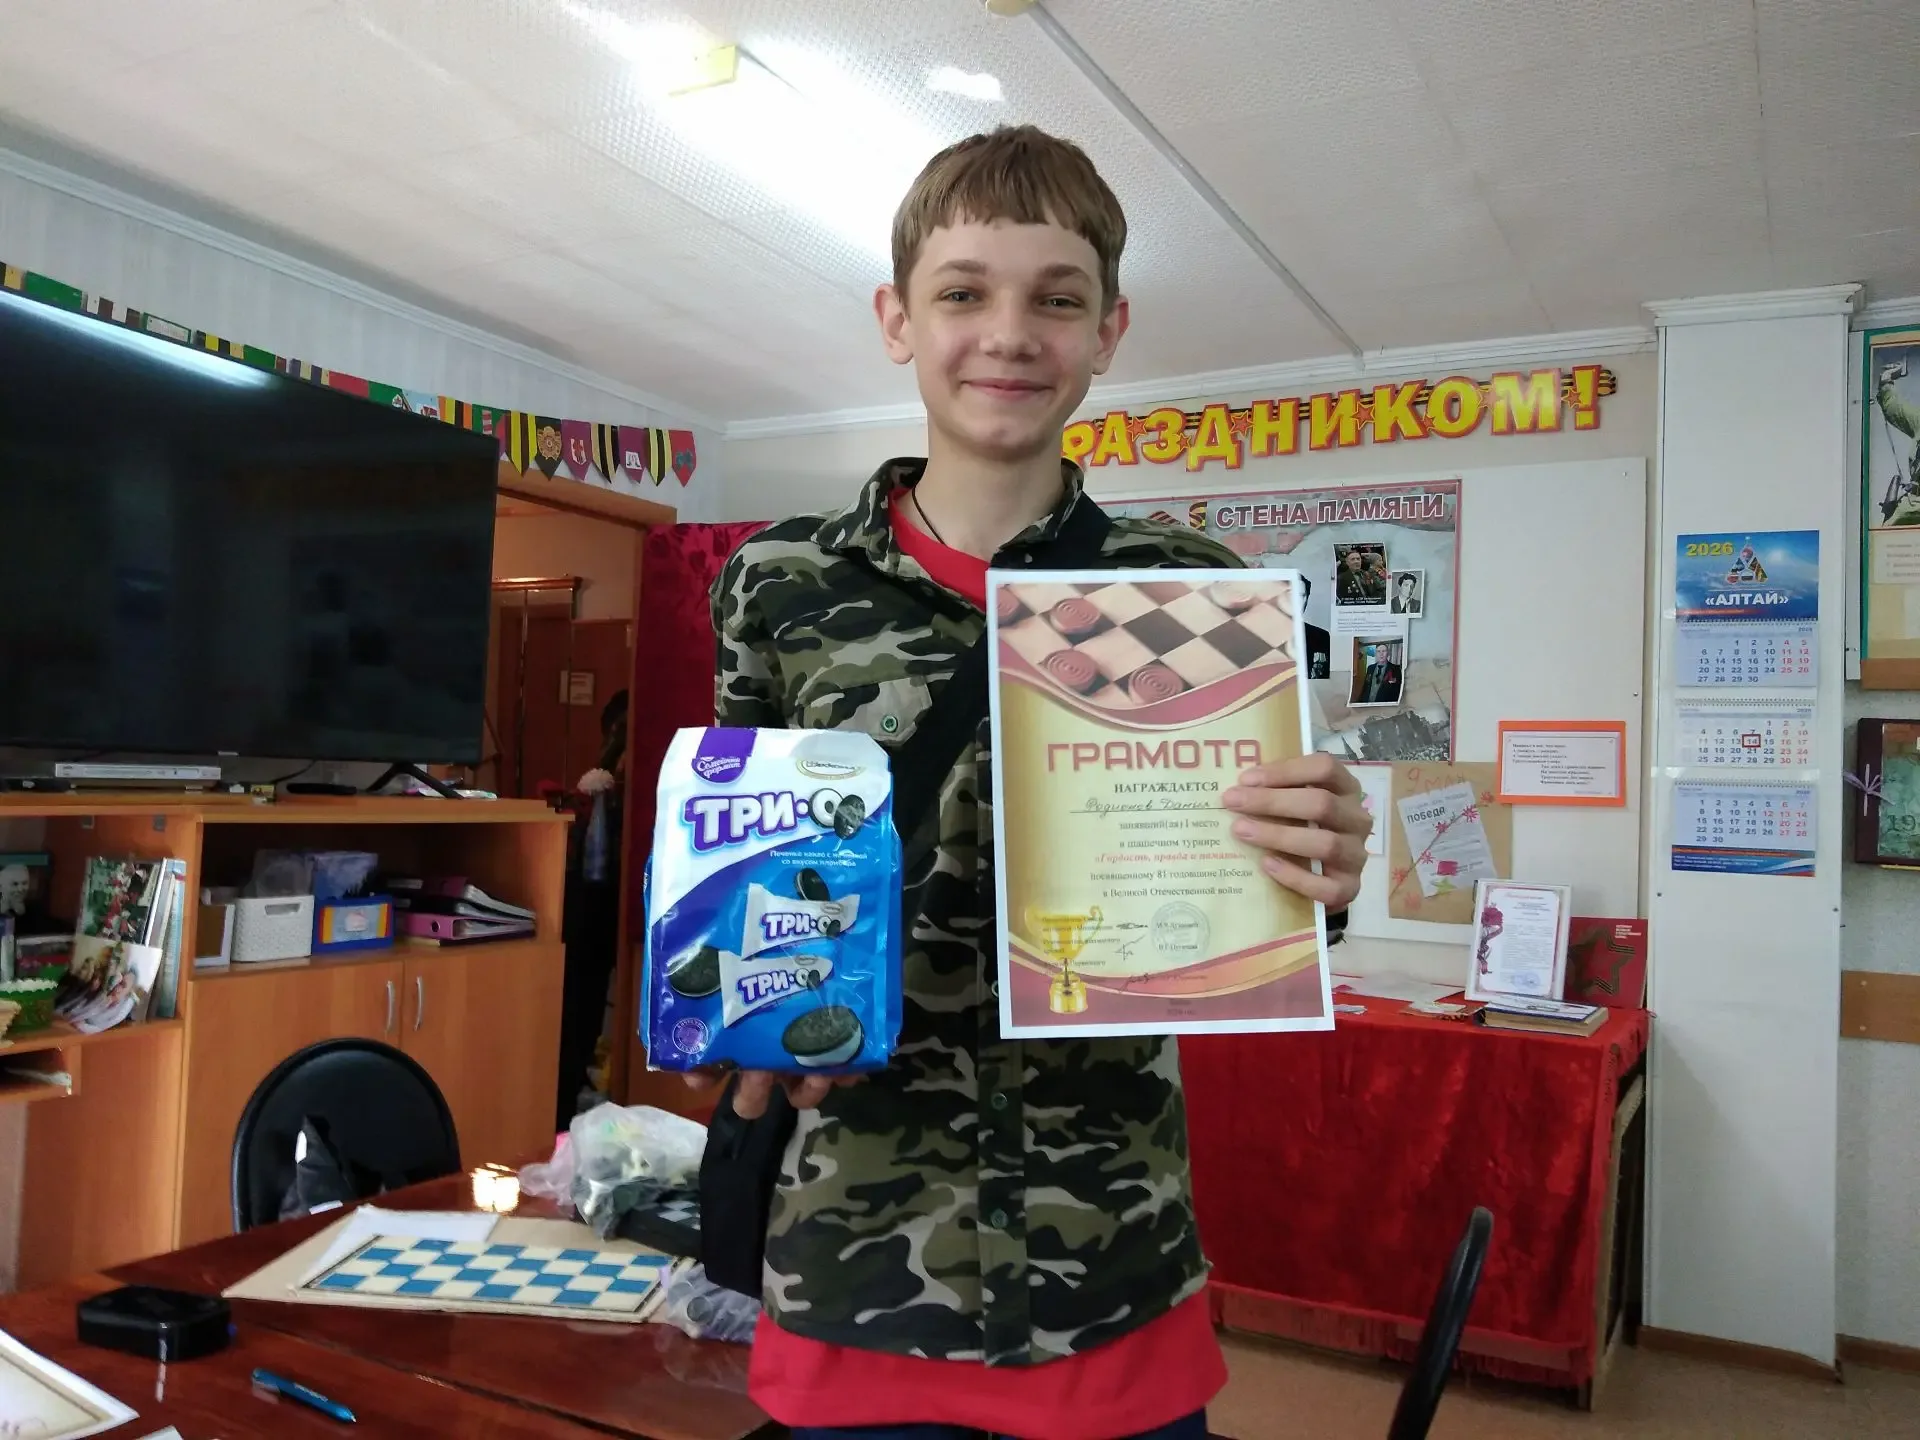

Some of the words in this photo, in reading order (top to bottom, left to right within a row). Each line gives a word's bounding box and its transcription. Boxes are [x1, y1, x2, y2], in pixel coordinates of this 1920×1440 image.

[1062, 364, 1602, 473] РАЗДНИКОМ!
[1215, 502, 1310, 529] СТЕНА
[1317, 493, 1445, 523] ПАМЯТИ
[1686, 542, 1734, 556] 2026
[1705, 591, 1789, 606] «АЛТАЙ»
[1047, 739, 1262, 772] ГРАМОТА
[1114, 781, 1219, 793] НАГРАЖДАЕТСЯ
[1407, 806, 1446, 824] ПОБЕДА
[1191, 820, 1220, 829] место
[1127, 839, 1179, 848] шашечном
[1183, 838, 1221, 850] турнире
[1218, 868, 1253, 878] Победы
[1110, 889, 1147, 898] Великой
[1150, 887, 1215, 897] Отечественной
[1218, 886, 1243, 895] войне
